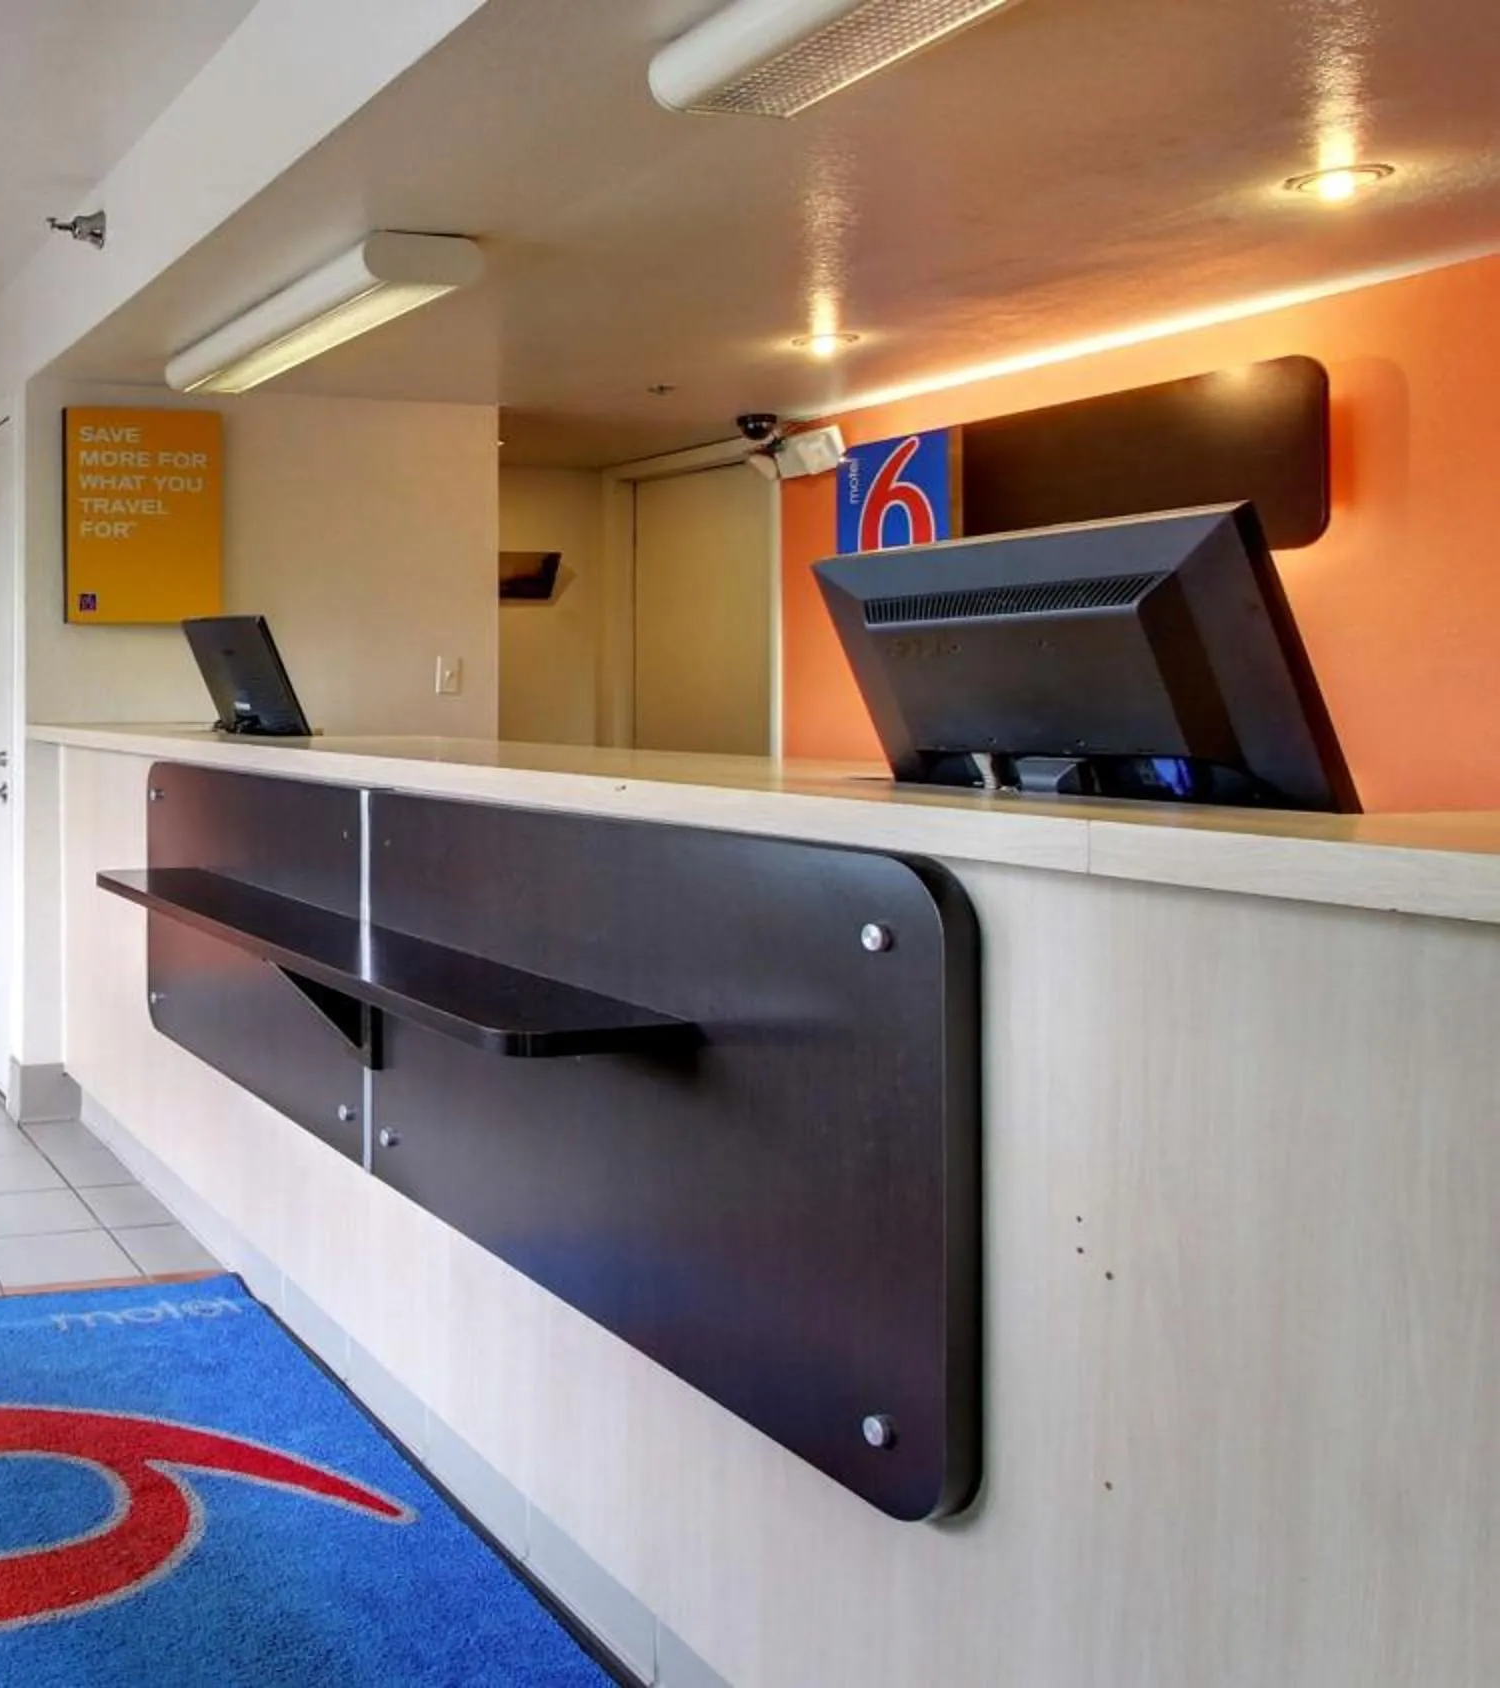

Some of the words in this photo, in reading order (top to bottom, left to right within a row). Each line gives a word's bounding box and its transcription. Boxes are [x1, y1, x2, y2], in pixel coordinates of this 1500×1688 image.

[79, 426, 141, 443] SAVE
[79, 451, 149, 467] MORE
[158, 452, 208, 469] FOR
[79, 475, 147, 490] WHAT
[153, 476, 203, 492] YOU
[842, 456, 860, 505] motel
[857, 435, 936, 553] 6
[79, 499, 169, 515] TRAVEL
[51, 1298, 243, 1332] motel
